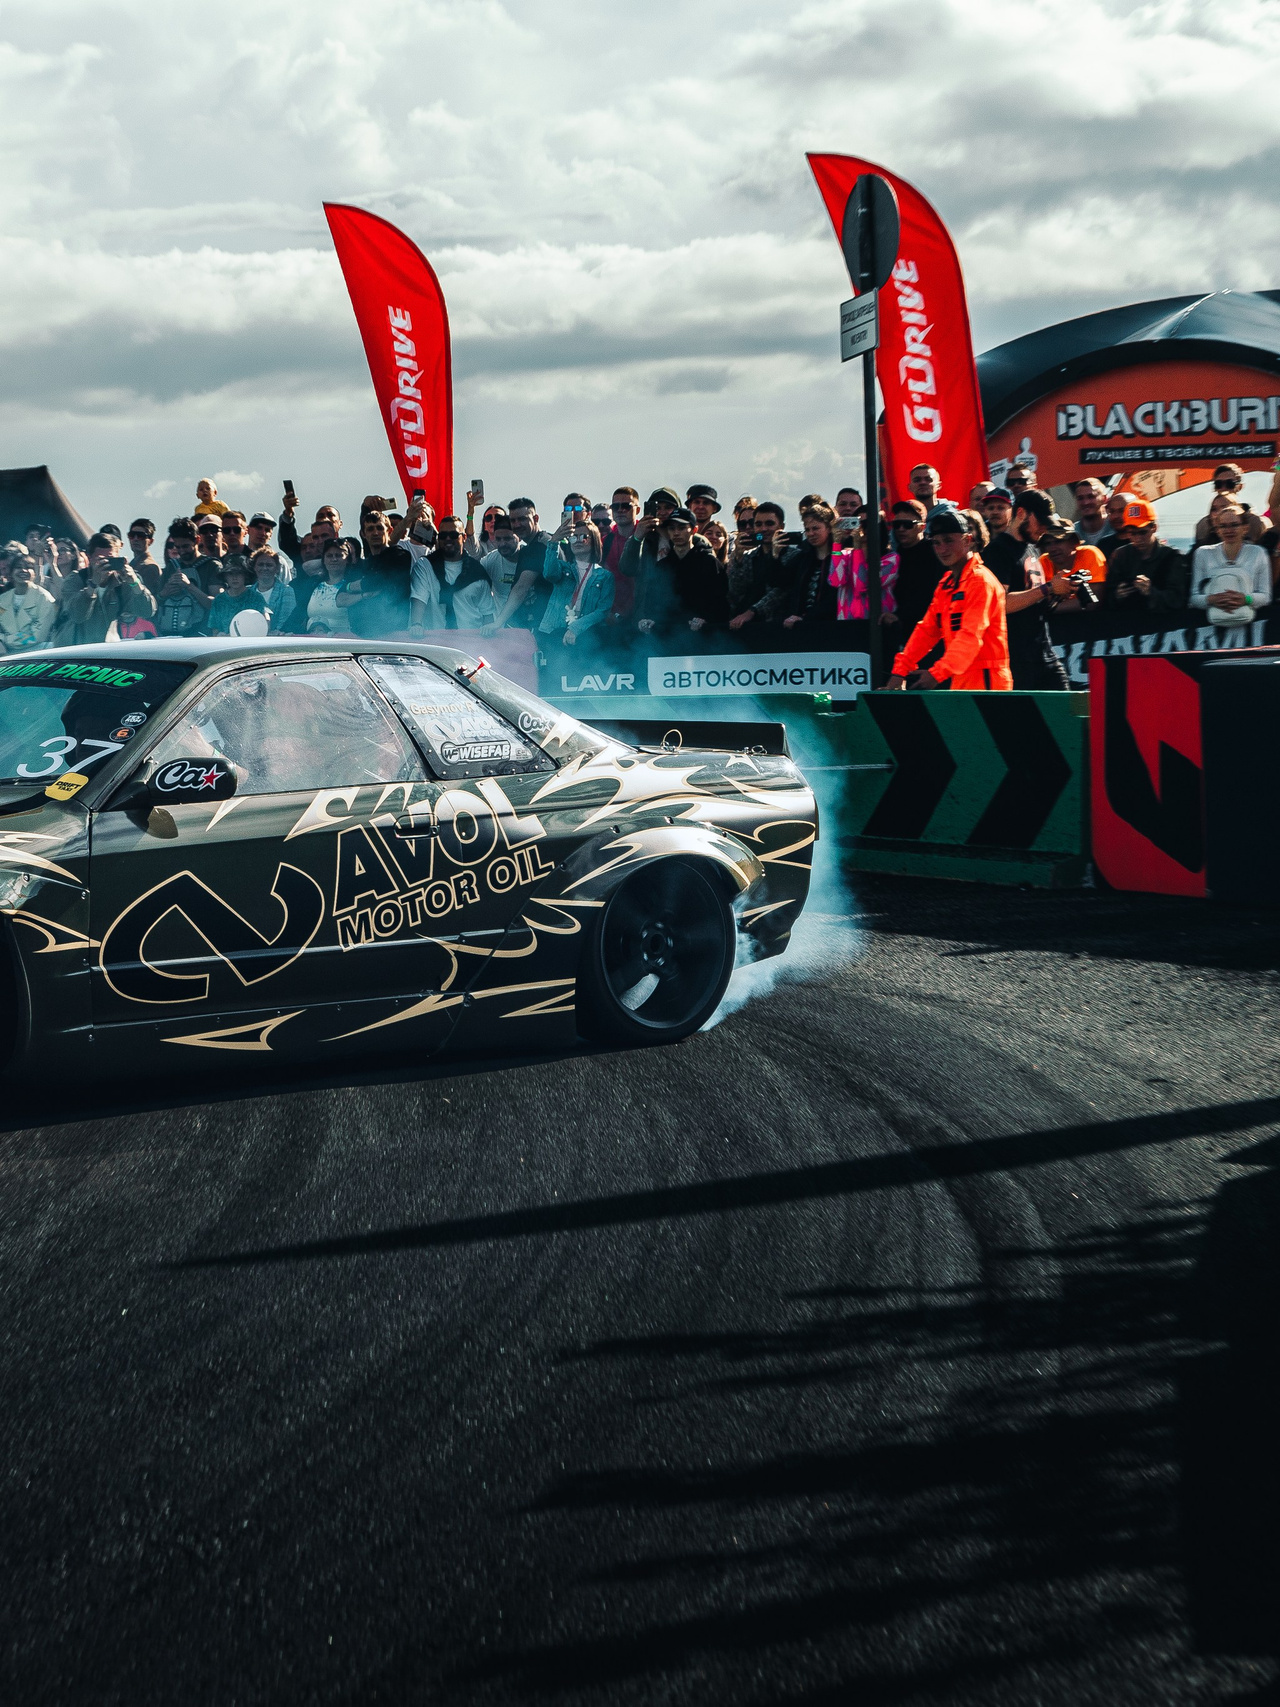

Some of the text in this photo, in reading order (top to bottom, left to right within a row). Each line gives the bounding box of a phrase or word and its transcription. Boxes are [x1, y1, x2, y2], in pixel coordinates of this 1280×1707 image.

[1085, 450, 1141, 461] ЛУЧШЕЕ
[1144, 449, 1155, 459] В
[49, 664, 144, 687] PICNIC
[561, 674, 635, 692] LAVR
[663, 667, 868, 688] автокосметика
[410, 703, 462, 715] Gasymov
[17, 736, 125, 777] 37
[459, 743, 510, 759] WISEFAB
[333, 777, 547, 916] AVOL
[337, 845, 555, 951] MOTOR OIL
